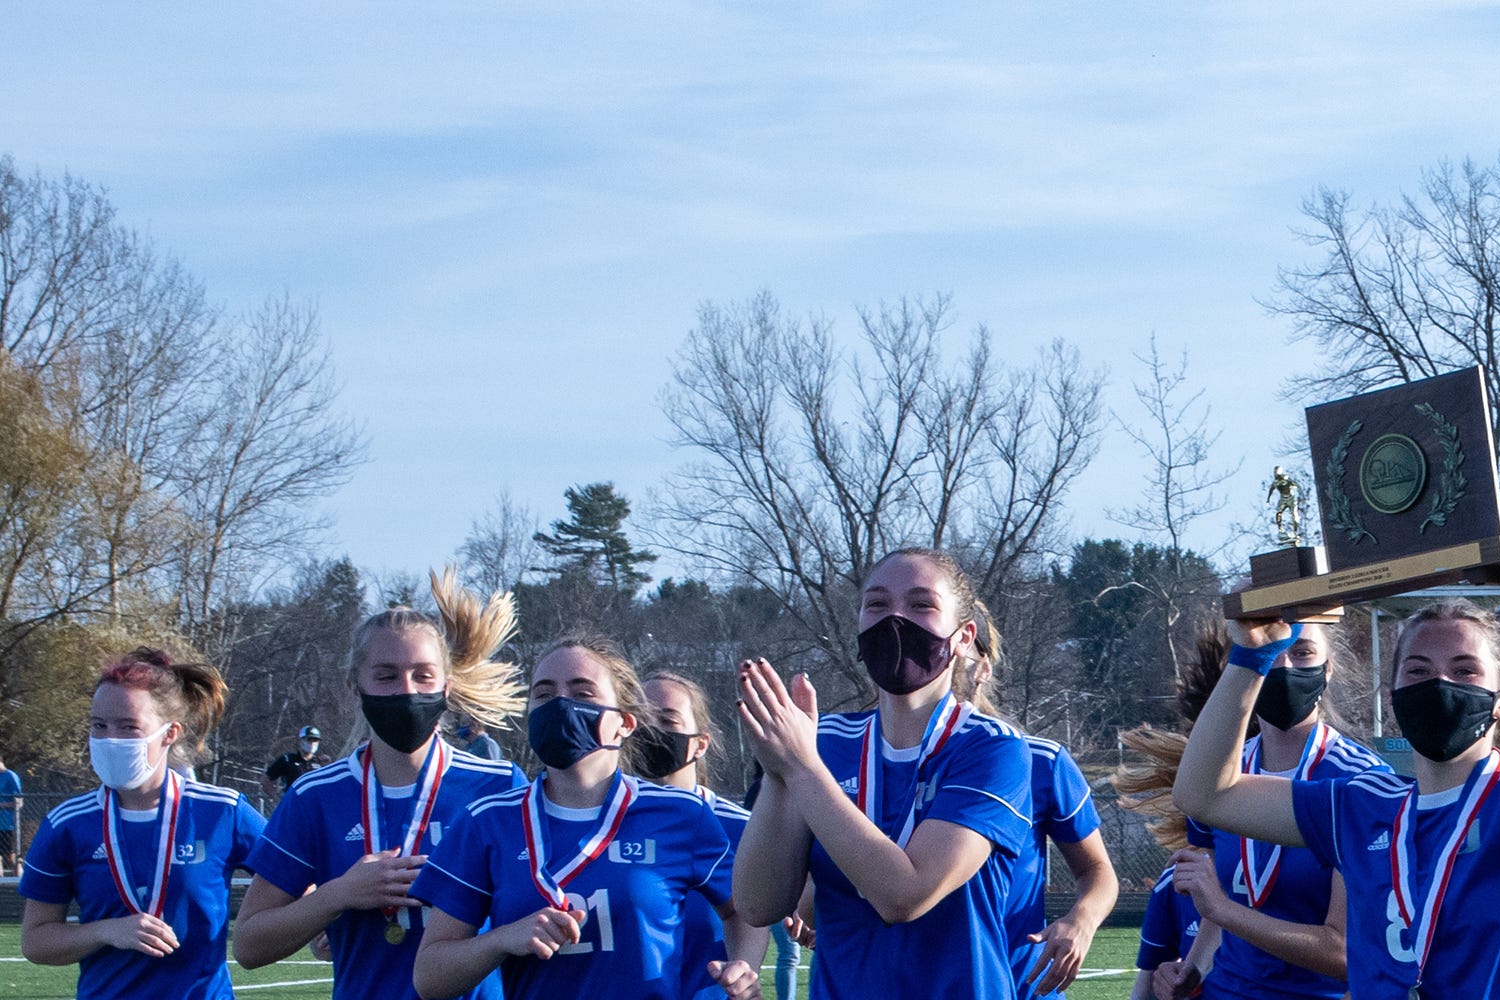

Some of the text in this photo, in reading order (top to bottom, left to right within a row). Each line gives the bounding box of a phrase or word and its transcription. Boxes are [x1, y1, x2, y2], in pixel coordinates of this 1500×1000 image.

[176, 844, 194, 858] 32
[622, 842, 642, 856] 32
[558, 888, 615, 955] 21
